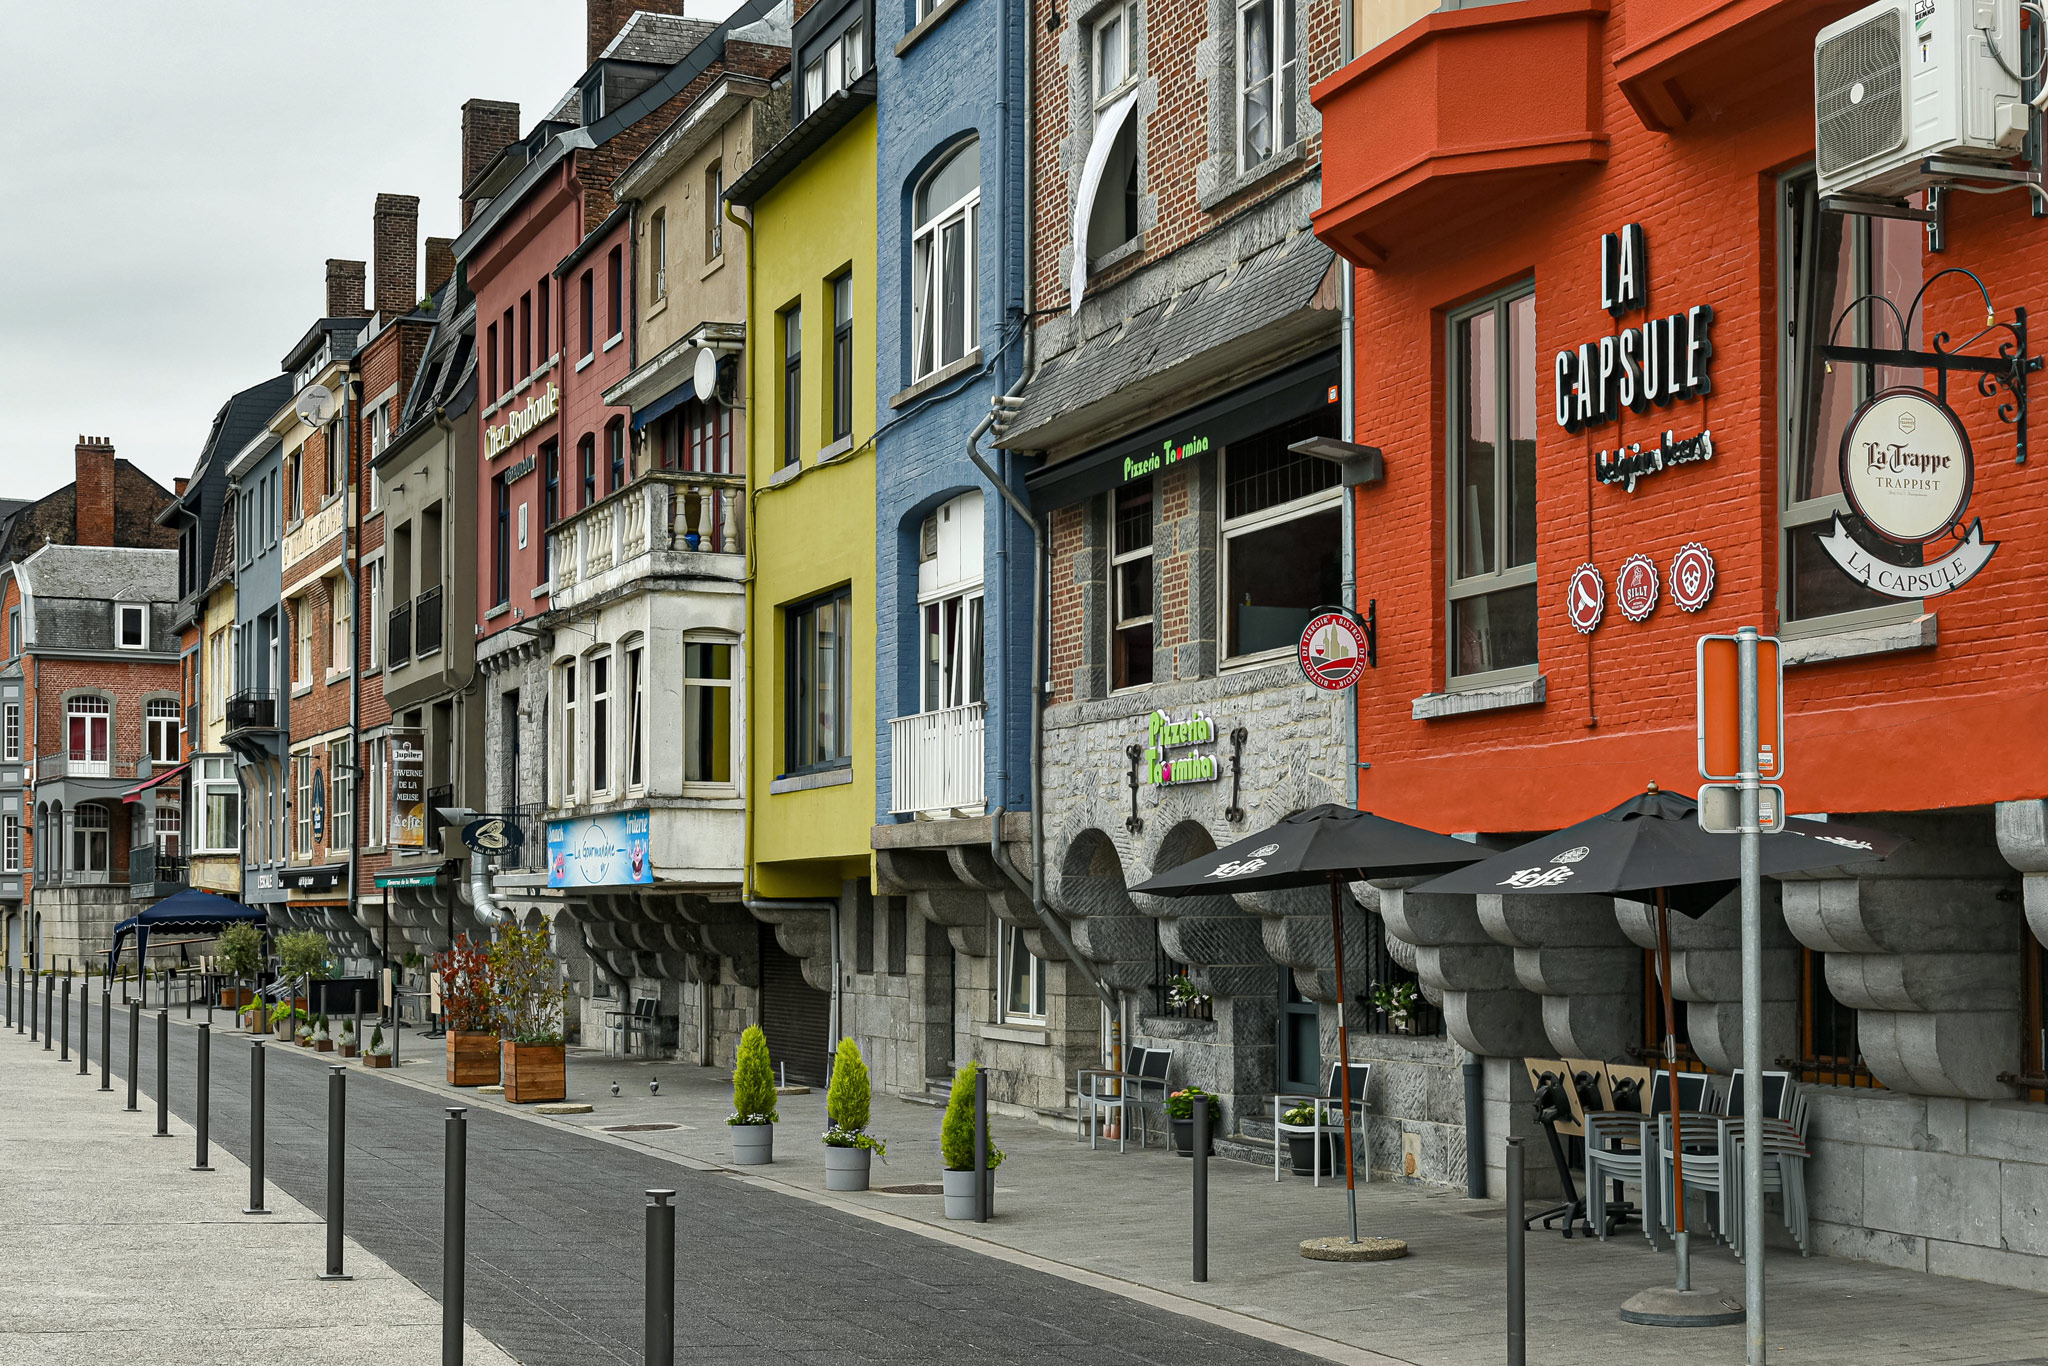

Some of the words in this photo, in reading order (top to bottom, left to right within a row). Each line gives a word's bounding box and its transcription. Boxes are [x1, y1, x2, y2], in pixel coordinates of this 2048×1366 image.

[1915, 7, 1936, 21] REMKO
[1601, 223, 1640, 312] LA
[1555, 305, 1706, 429] CAPSULE
[484, 424, 509, 461] Chez
[508, 381, 560, 444] Bouboule
[1124, 452, 1161, 481] Pizzeria
[1862, 442, 1887, 475] La
[1887, 443, 1952, 475] Trappe
[1875, 476, 1941, 491] TRAPPIST
[1847, 551, 1873, 580] LA
[1878, 557, 1967, 592] CAPSULE
[1627, 585, 1648, 600] SILLY
[1339, 618, 1364, 644] BISTROT
[1359, 648, 1365, 659] DE
[1302, 646, 1308, 657] DE
[1303, 661, 1329, 688] BISTROT
[1148, 711, 1213, 748] Pizzeria
[395, 750, 421, 759] Jupiler
[393, 769, 423, 777] TAVERNE
[399, 781, 407, 789] DE
[408, 781, 417, 789] LA
[396, 793, 419, 801] MEUSE
[394, 814, 421, 831] Leffe
[465, 840, 473, 848] Le
[474, 846, 485, 854] Roi
[1495, 865, 1575, 890] Leffe
